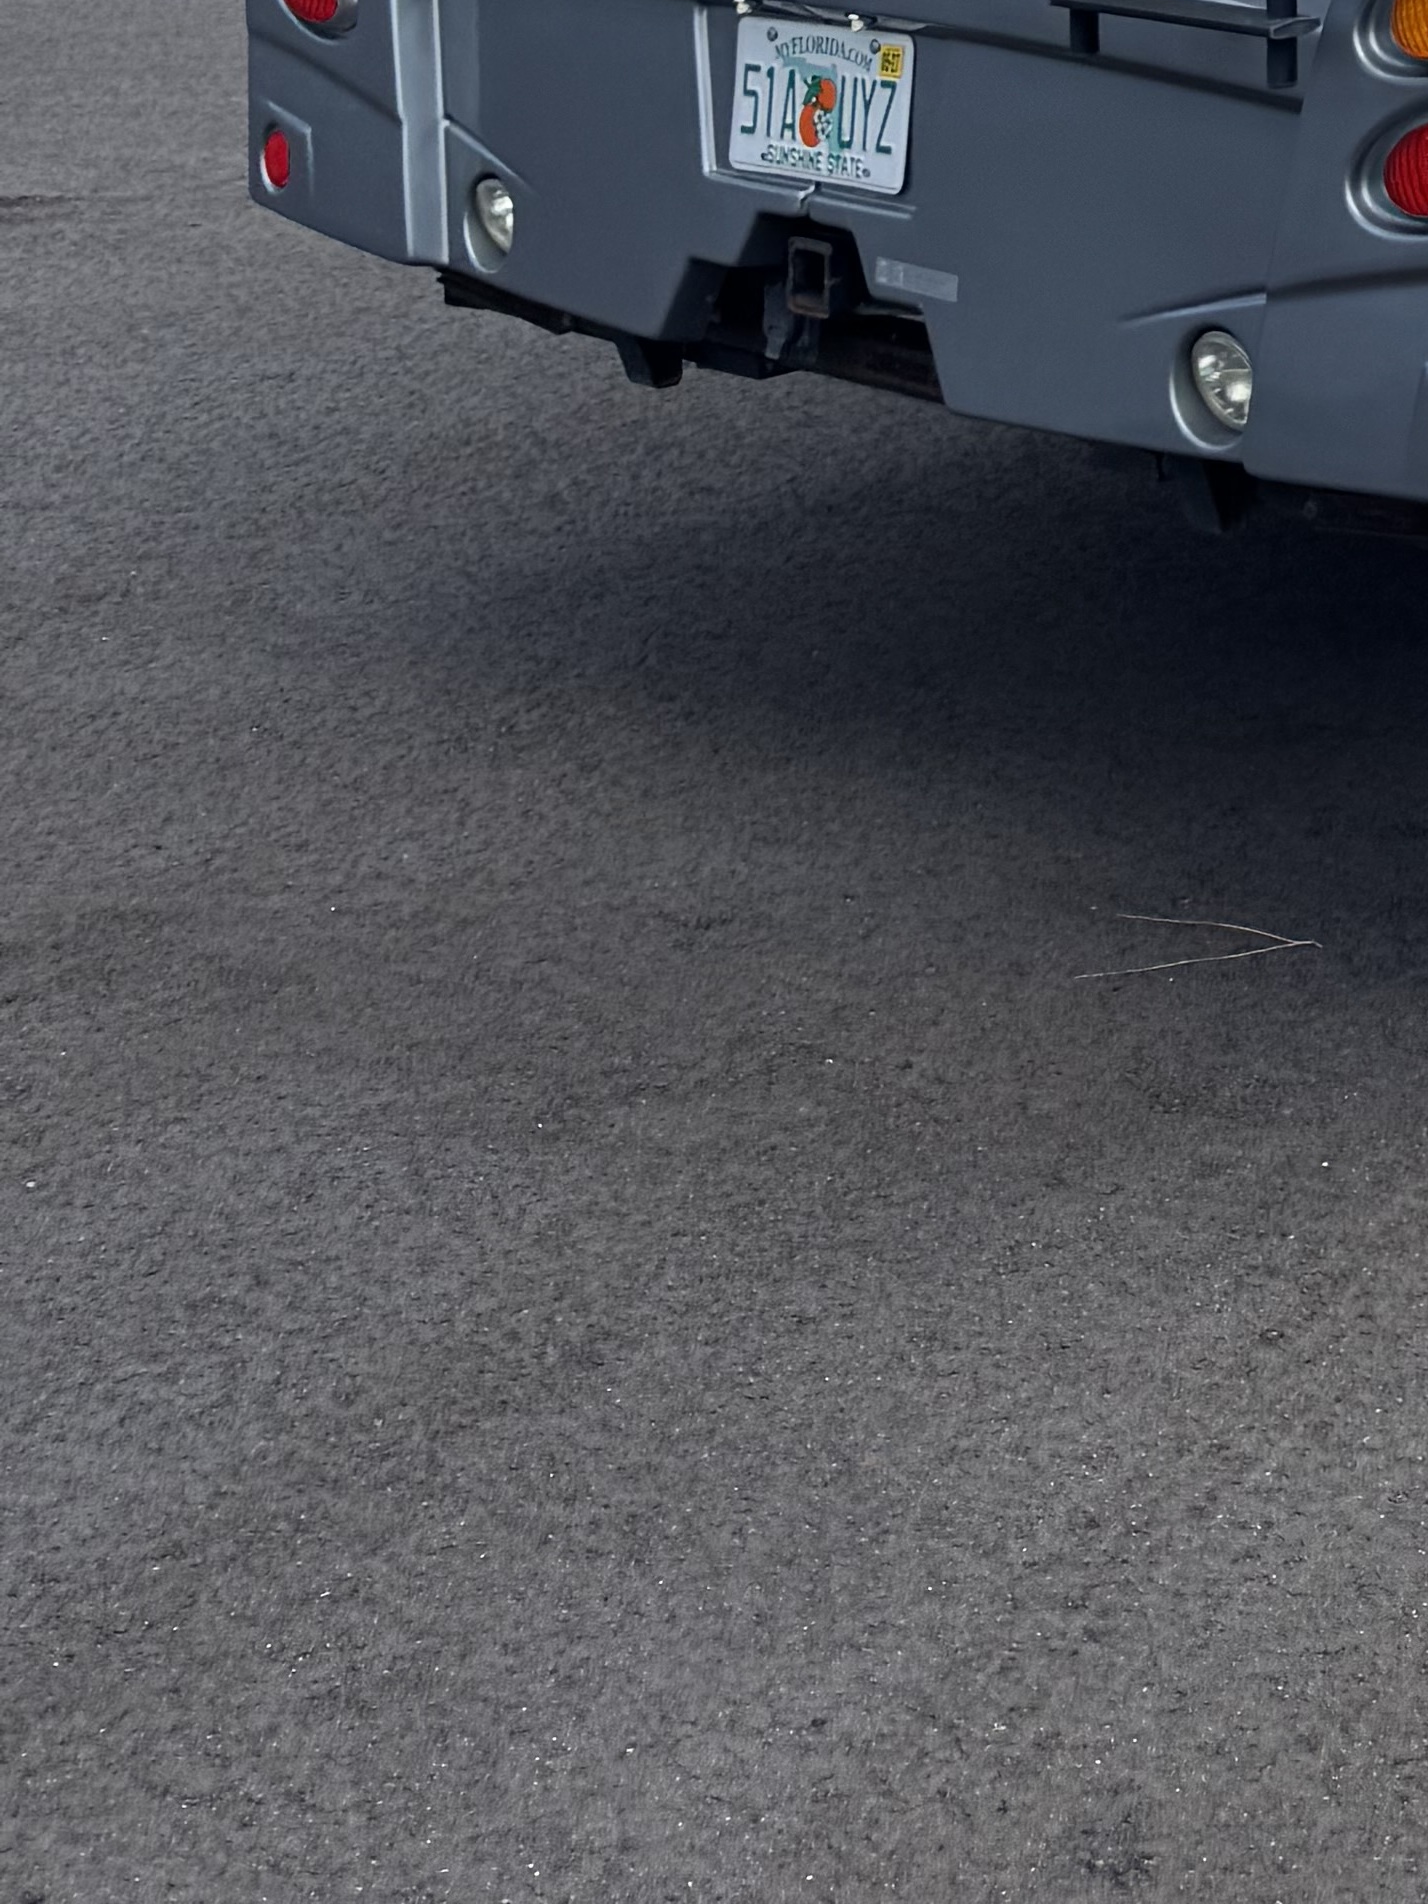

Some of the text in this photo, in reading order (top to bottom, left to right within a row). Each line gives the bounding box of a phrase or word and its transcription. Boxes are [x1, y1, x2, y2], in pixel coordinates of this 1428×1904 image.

[740, 63, 898, 156] 51A UYZ
[767, 143, 863, 179] SUNSHINE STATE
